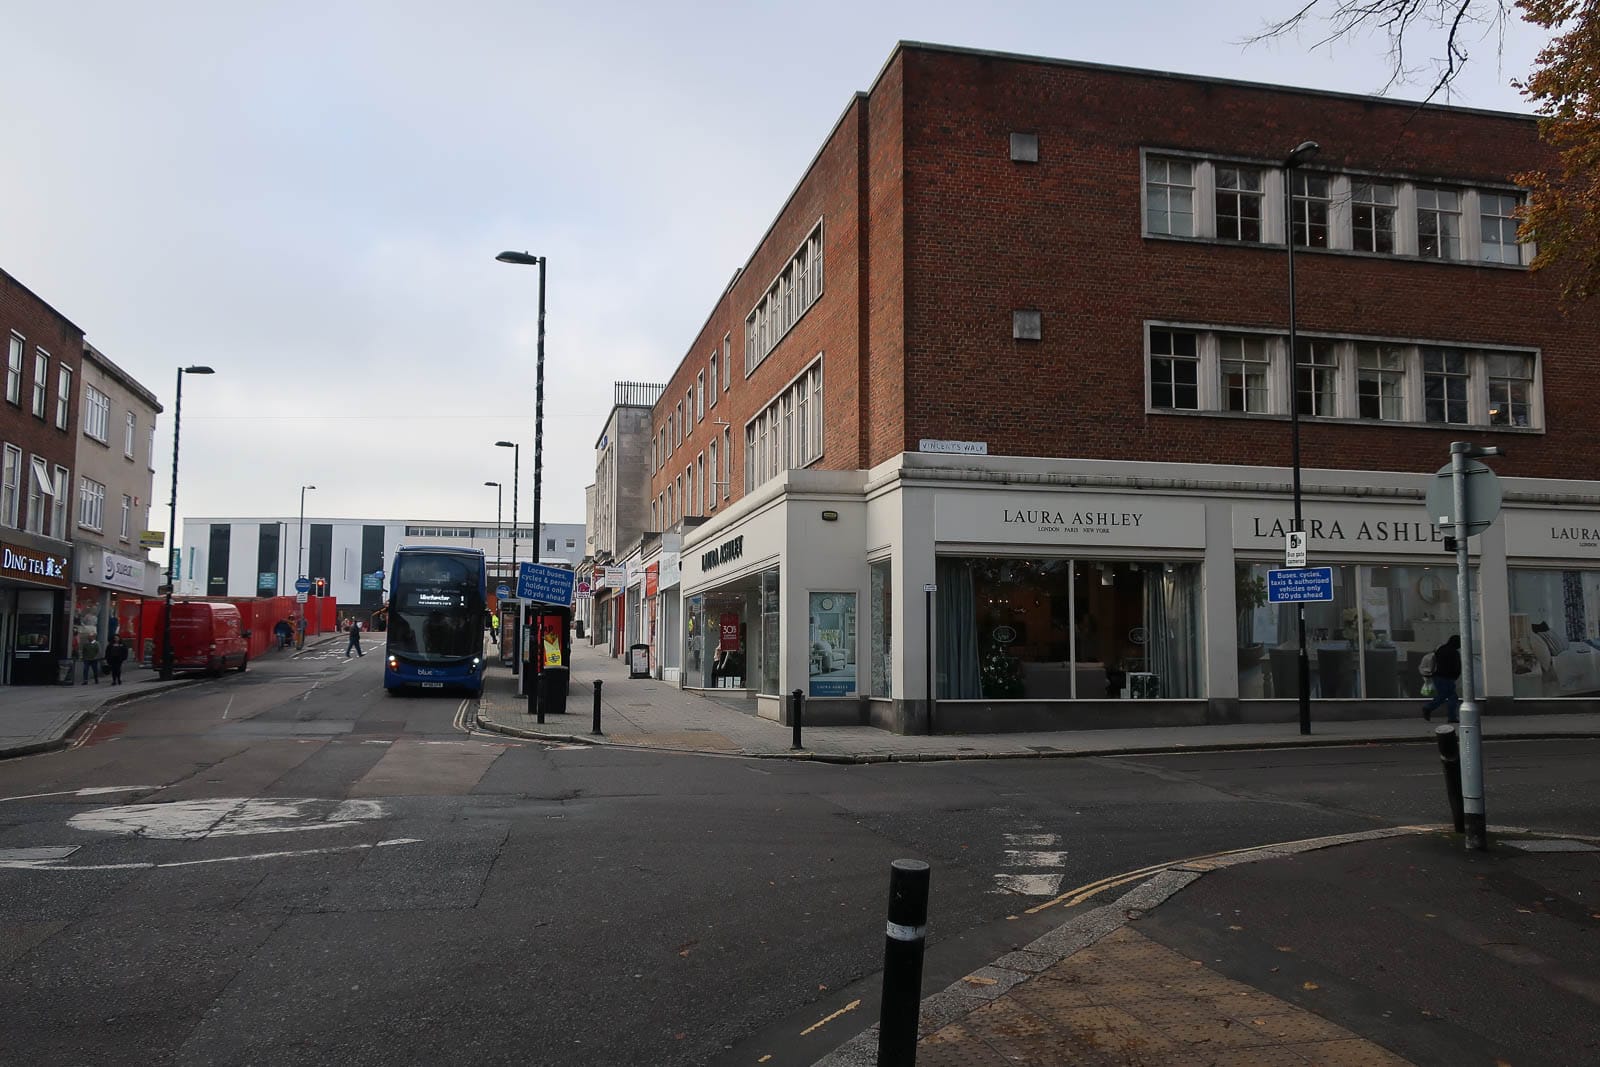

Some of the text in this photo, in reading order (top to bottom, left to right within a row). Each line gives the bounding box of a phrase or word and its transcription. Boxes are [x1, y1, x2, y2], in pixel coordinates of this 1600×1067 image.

[964, 444, 983, 452] WALK
[1004, 509, 1143, 526] LAURA ASHLEY
[1356, 520, 1443, 542] ASHLE
[1551, 527, 1600, 540] LAURA
[701, 547, 719, 573] LAURA
[720, 535, 744, 565] ASHLEY
[3, 548, 45, 576] DING TEA
[527, 566, 567, 579] Local buses,
[521, 574, 542, 583] cycles
[550, 579, 571, 588] permit
[525, 582, 566, 595] holders only
[546, 593, 566, 602] ahead
